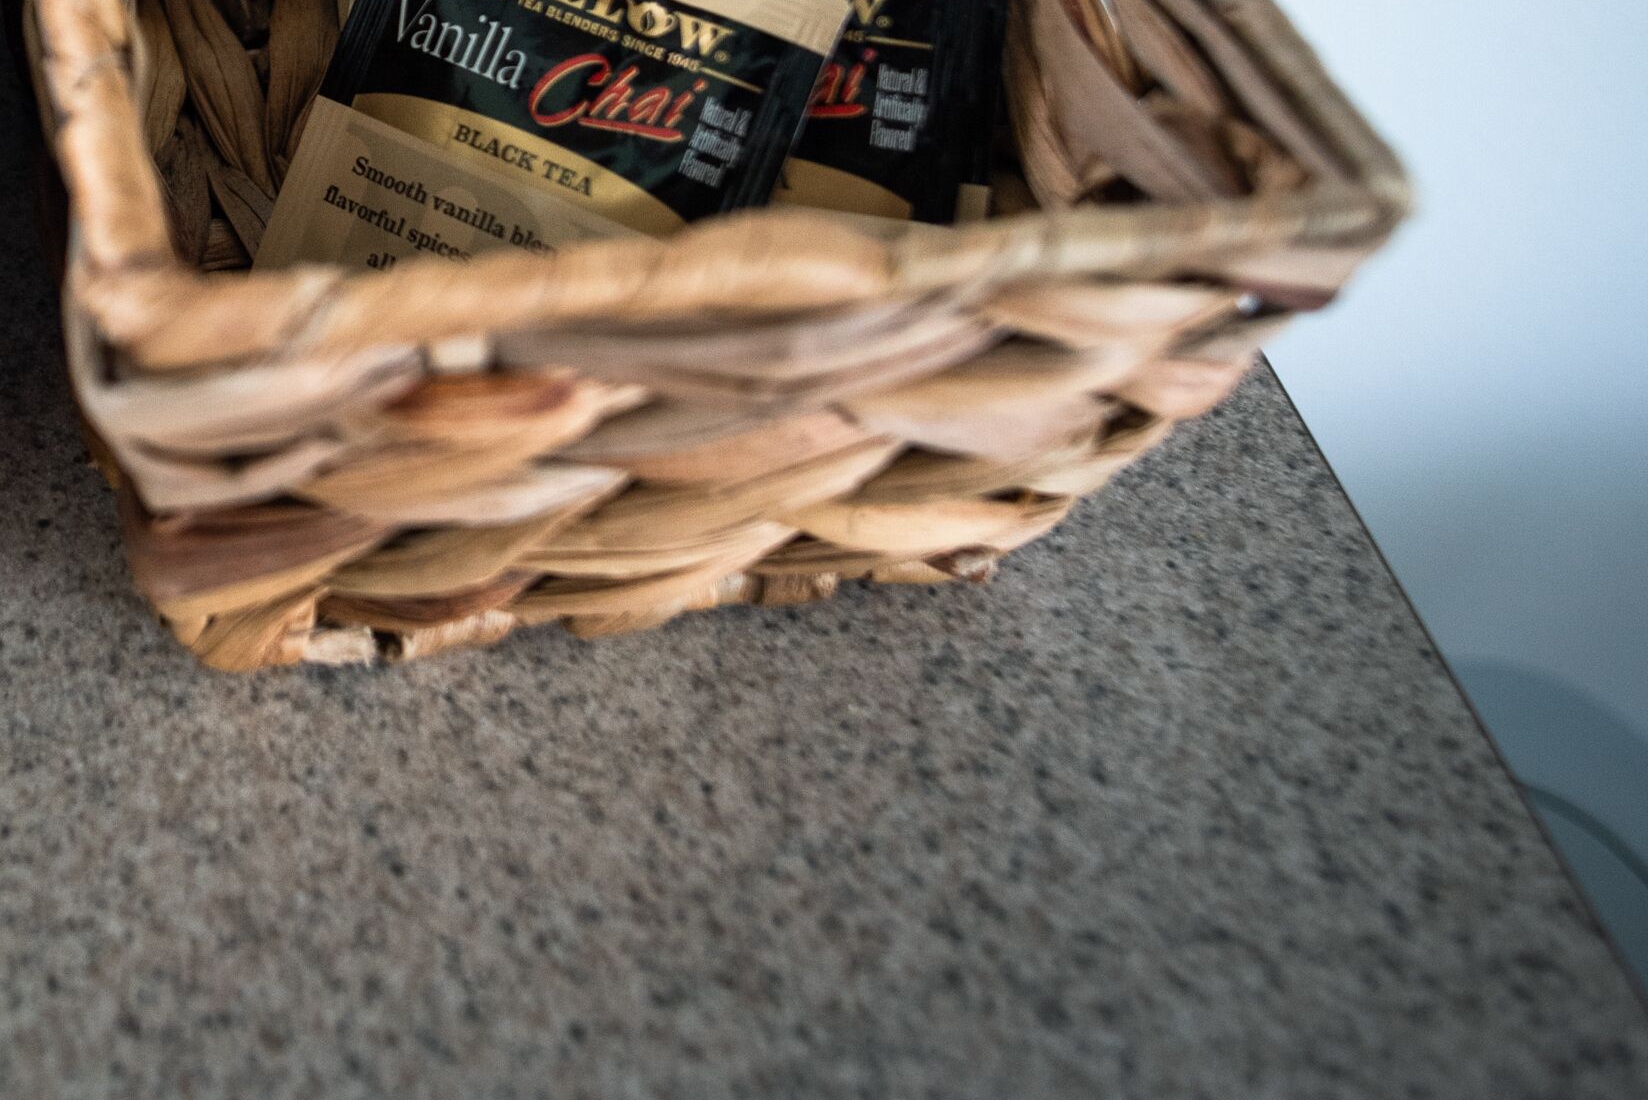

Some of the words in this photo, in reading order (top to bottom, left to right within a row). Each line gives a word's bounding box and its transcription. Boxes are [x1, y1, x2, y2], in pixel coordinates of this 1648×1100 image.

[545, 5, 619, 42] BLENDERS
[621, 33, 664, 61] SINCE
[528, 52, 709, 130] Chai
[451, 122, 538, 173] BLACK
[542, 159, 594, 196] TEA
[323, 184, 406, 238] flavorful
[351, 155, 429, 205] Smooth
[431, 193, 506, 240] vanilla
